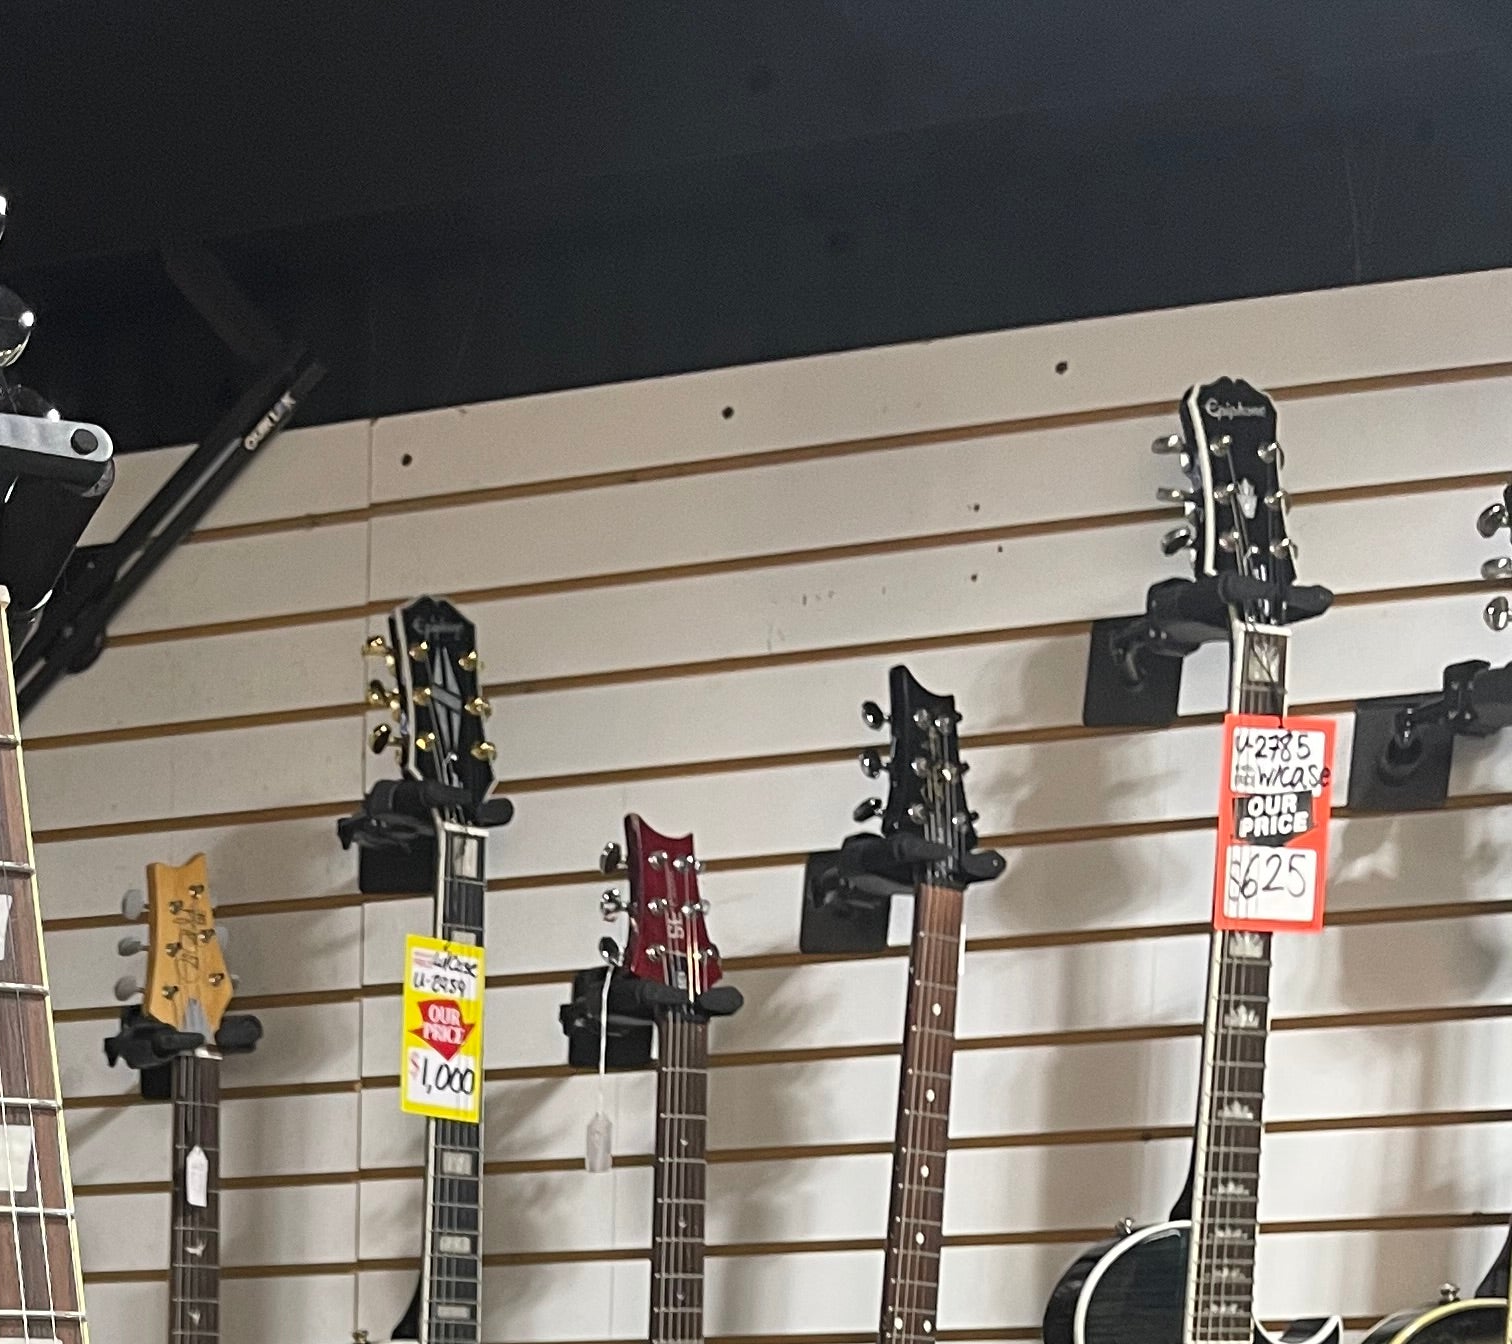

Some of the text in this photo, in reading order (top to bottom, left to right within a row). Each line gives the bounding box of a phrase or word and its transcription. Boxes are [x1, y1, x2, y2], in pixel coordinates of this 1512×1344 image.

[1247, 794, 1298, 817] OUR
[1239, 811, 1309, 838] PRICE
[428, 1004, 461, 1027] OUR
